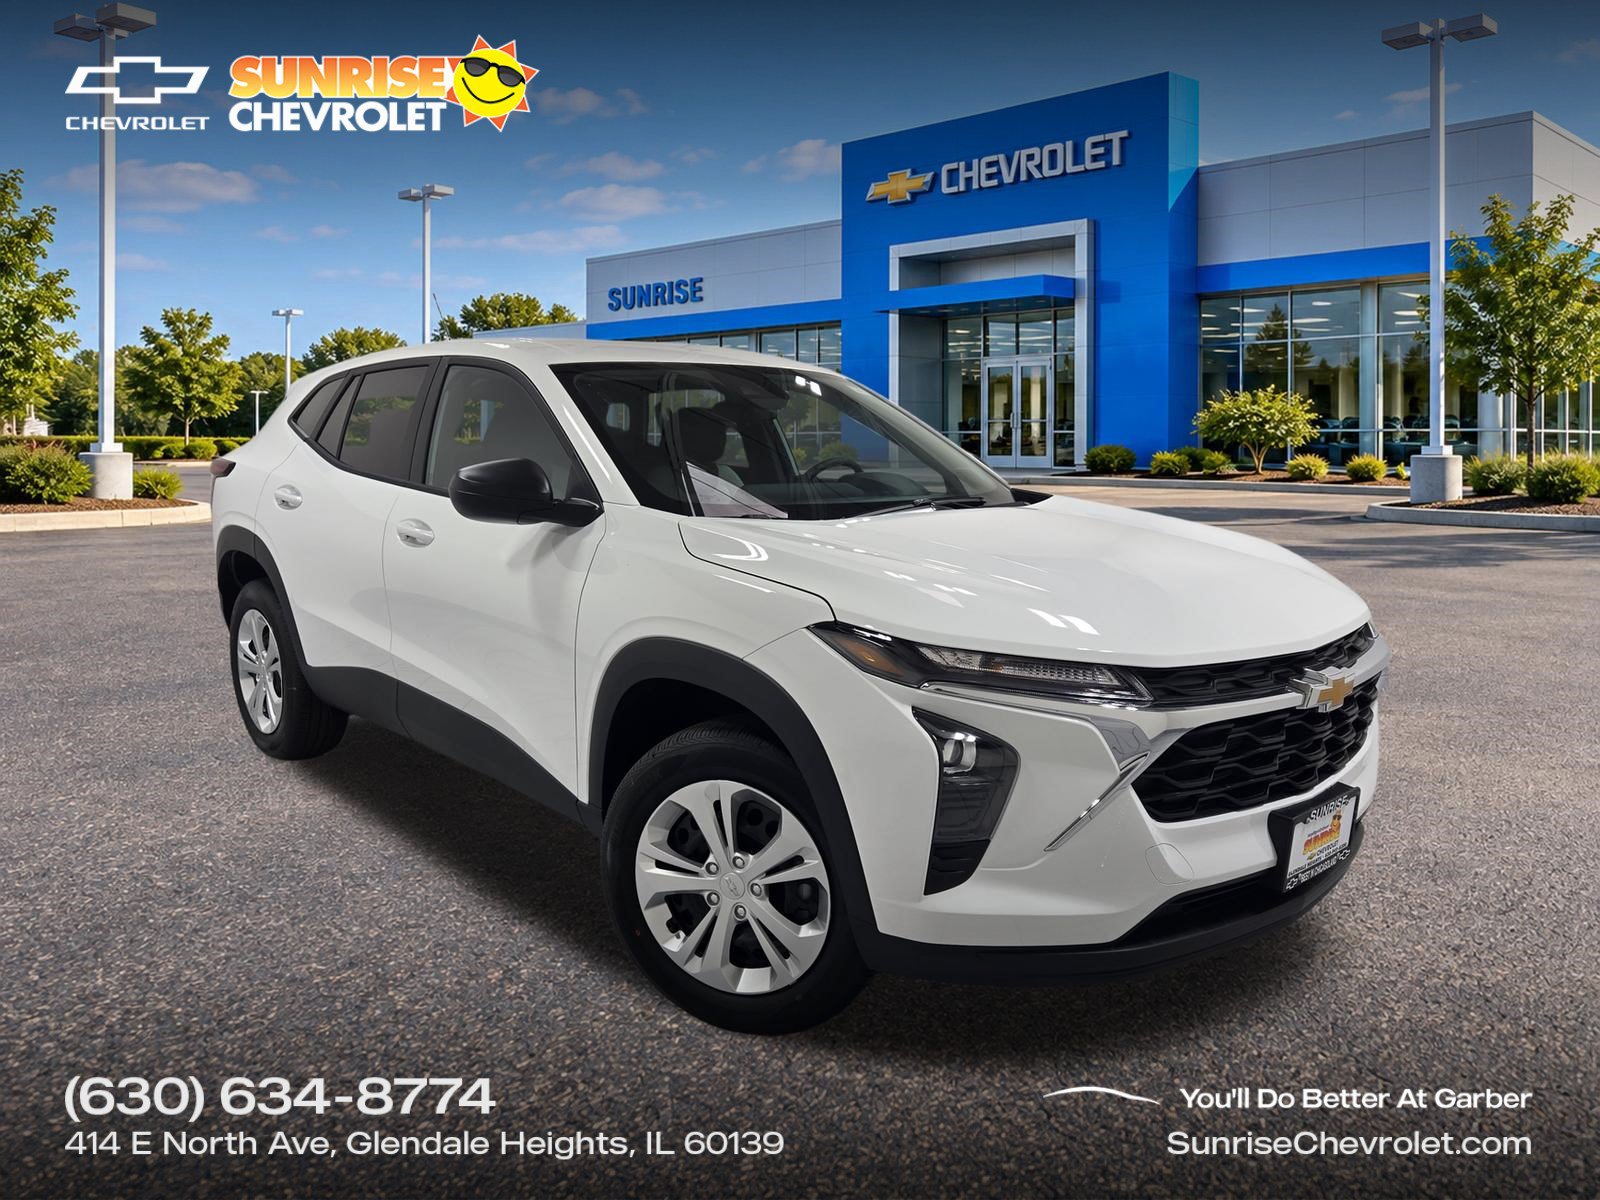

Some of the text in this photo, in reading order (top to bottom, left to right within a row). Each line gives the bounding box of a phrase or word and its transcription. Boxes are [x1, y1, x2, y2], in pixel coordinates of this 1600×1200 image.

[940, 129, 1129, 195] CHEVROLET
[607, 276, 704, 312] SUNRISE
[1310, 795, 1347, 820] SUNRISE
